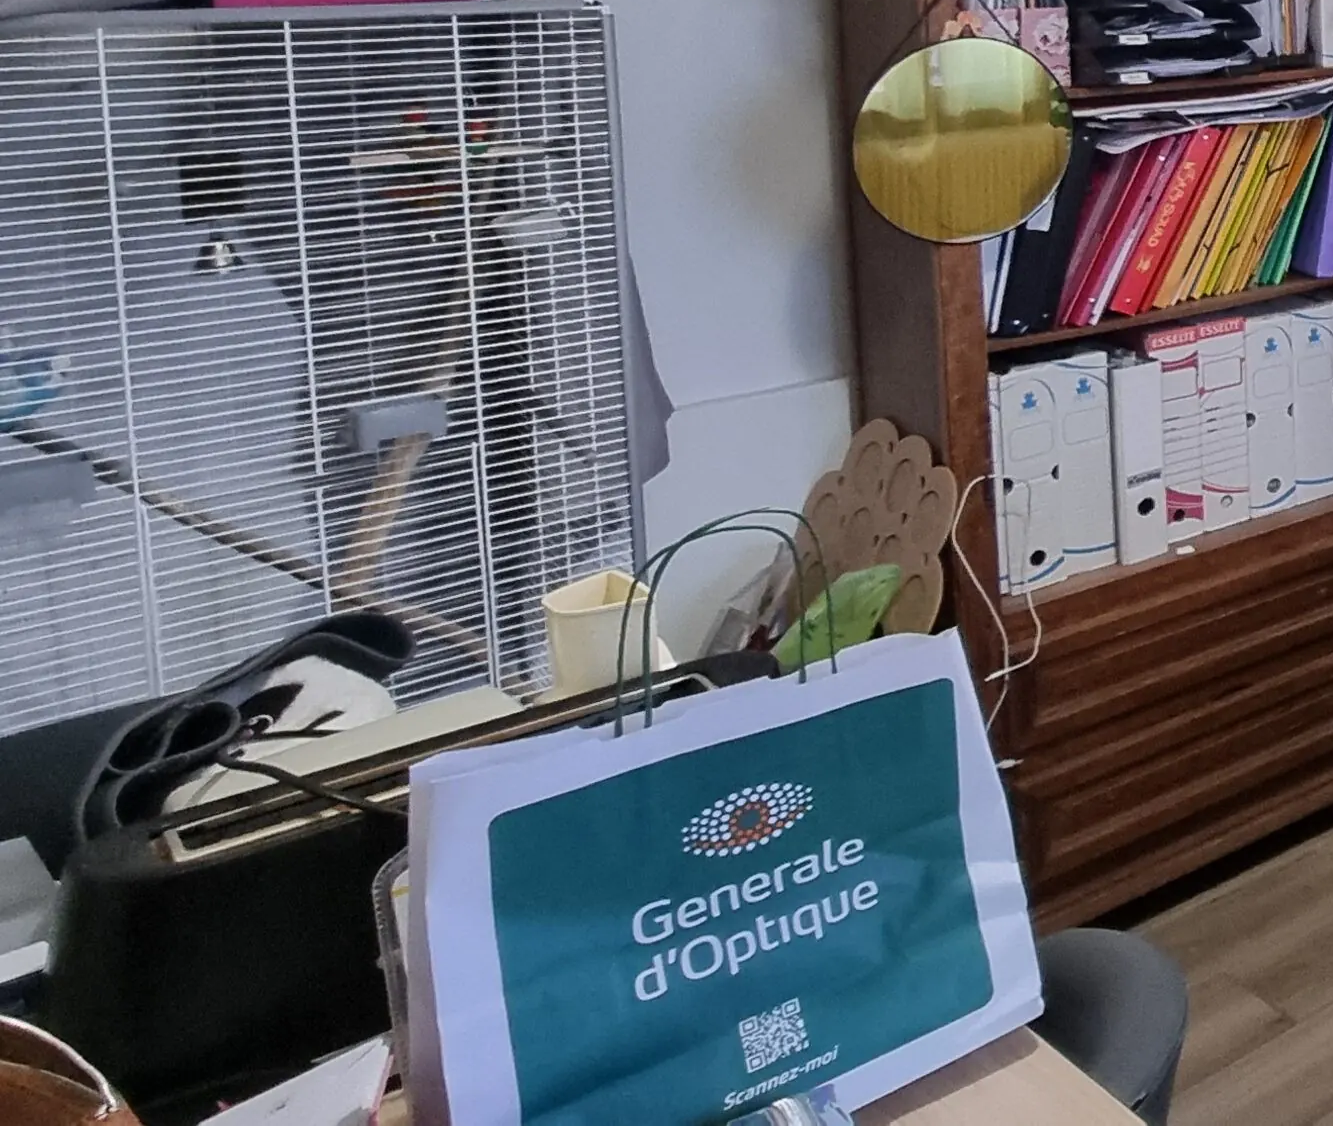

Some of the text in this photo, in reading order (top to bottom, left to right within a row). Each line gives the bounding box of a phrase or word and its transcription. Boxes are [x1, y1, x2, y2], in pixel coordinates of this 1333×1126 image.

[631, 837, 865, 944] Generale
[634, 880, 879, 1002] d'Optique
[723, 1045, 840, 1111] Scannez-moi
